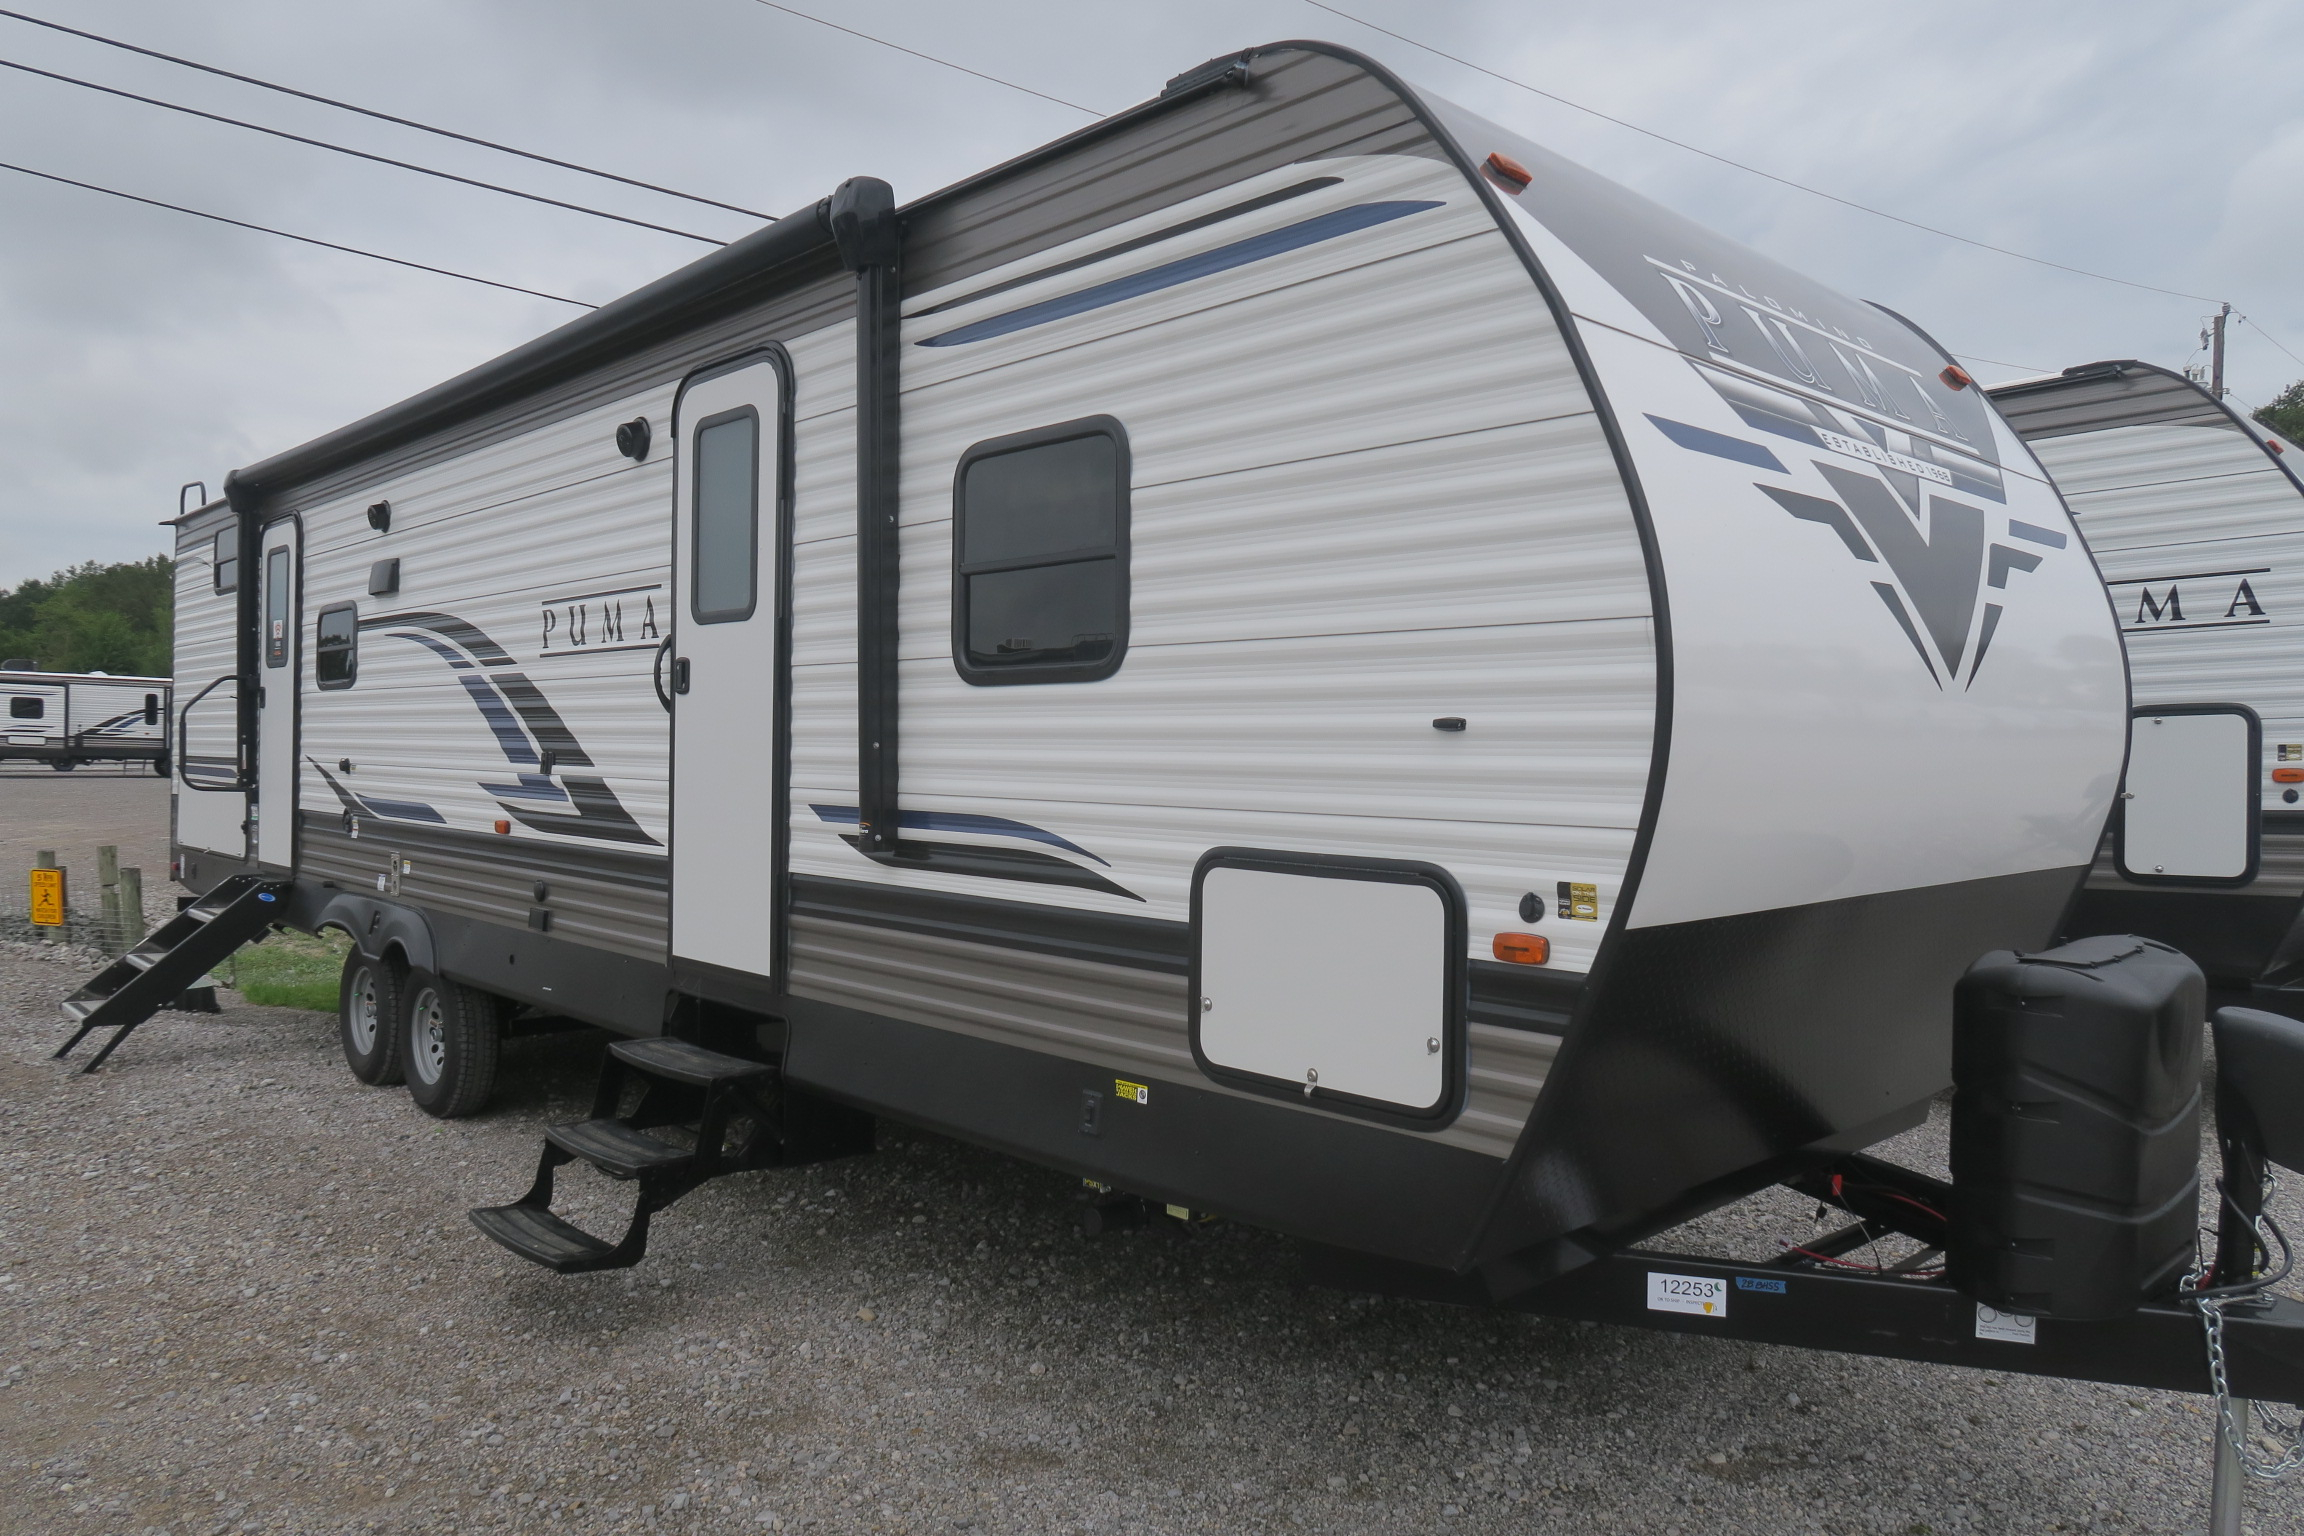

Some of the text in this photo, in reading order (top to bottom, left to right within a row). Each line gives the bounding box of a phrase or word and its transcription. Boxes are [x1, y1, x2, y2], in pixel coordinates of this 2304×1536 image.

[1680, 258, 1873, 350] PALOMINO
[1659, 271, 1969, 441] PUMA
[1821, 433, 1950, 482] ESTABLISHED 1968
[542, 594, 659, 649] PUMA
[2134, 578, 2266, 623] MA
[1573, 895, 1596, 904] SIDE
[1660, 1278, 1714, 1298] 12253
